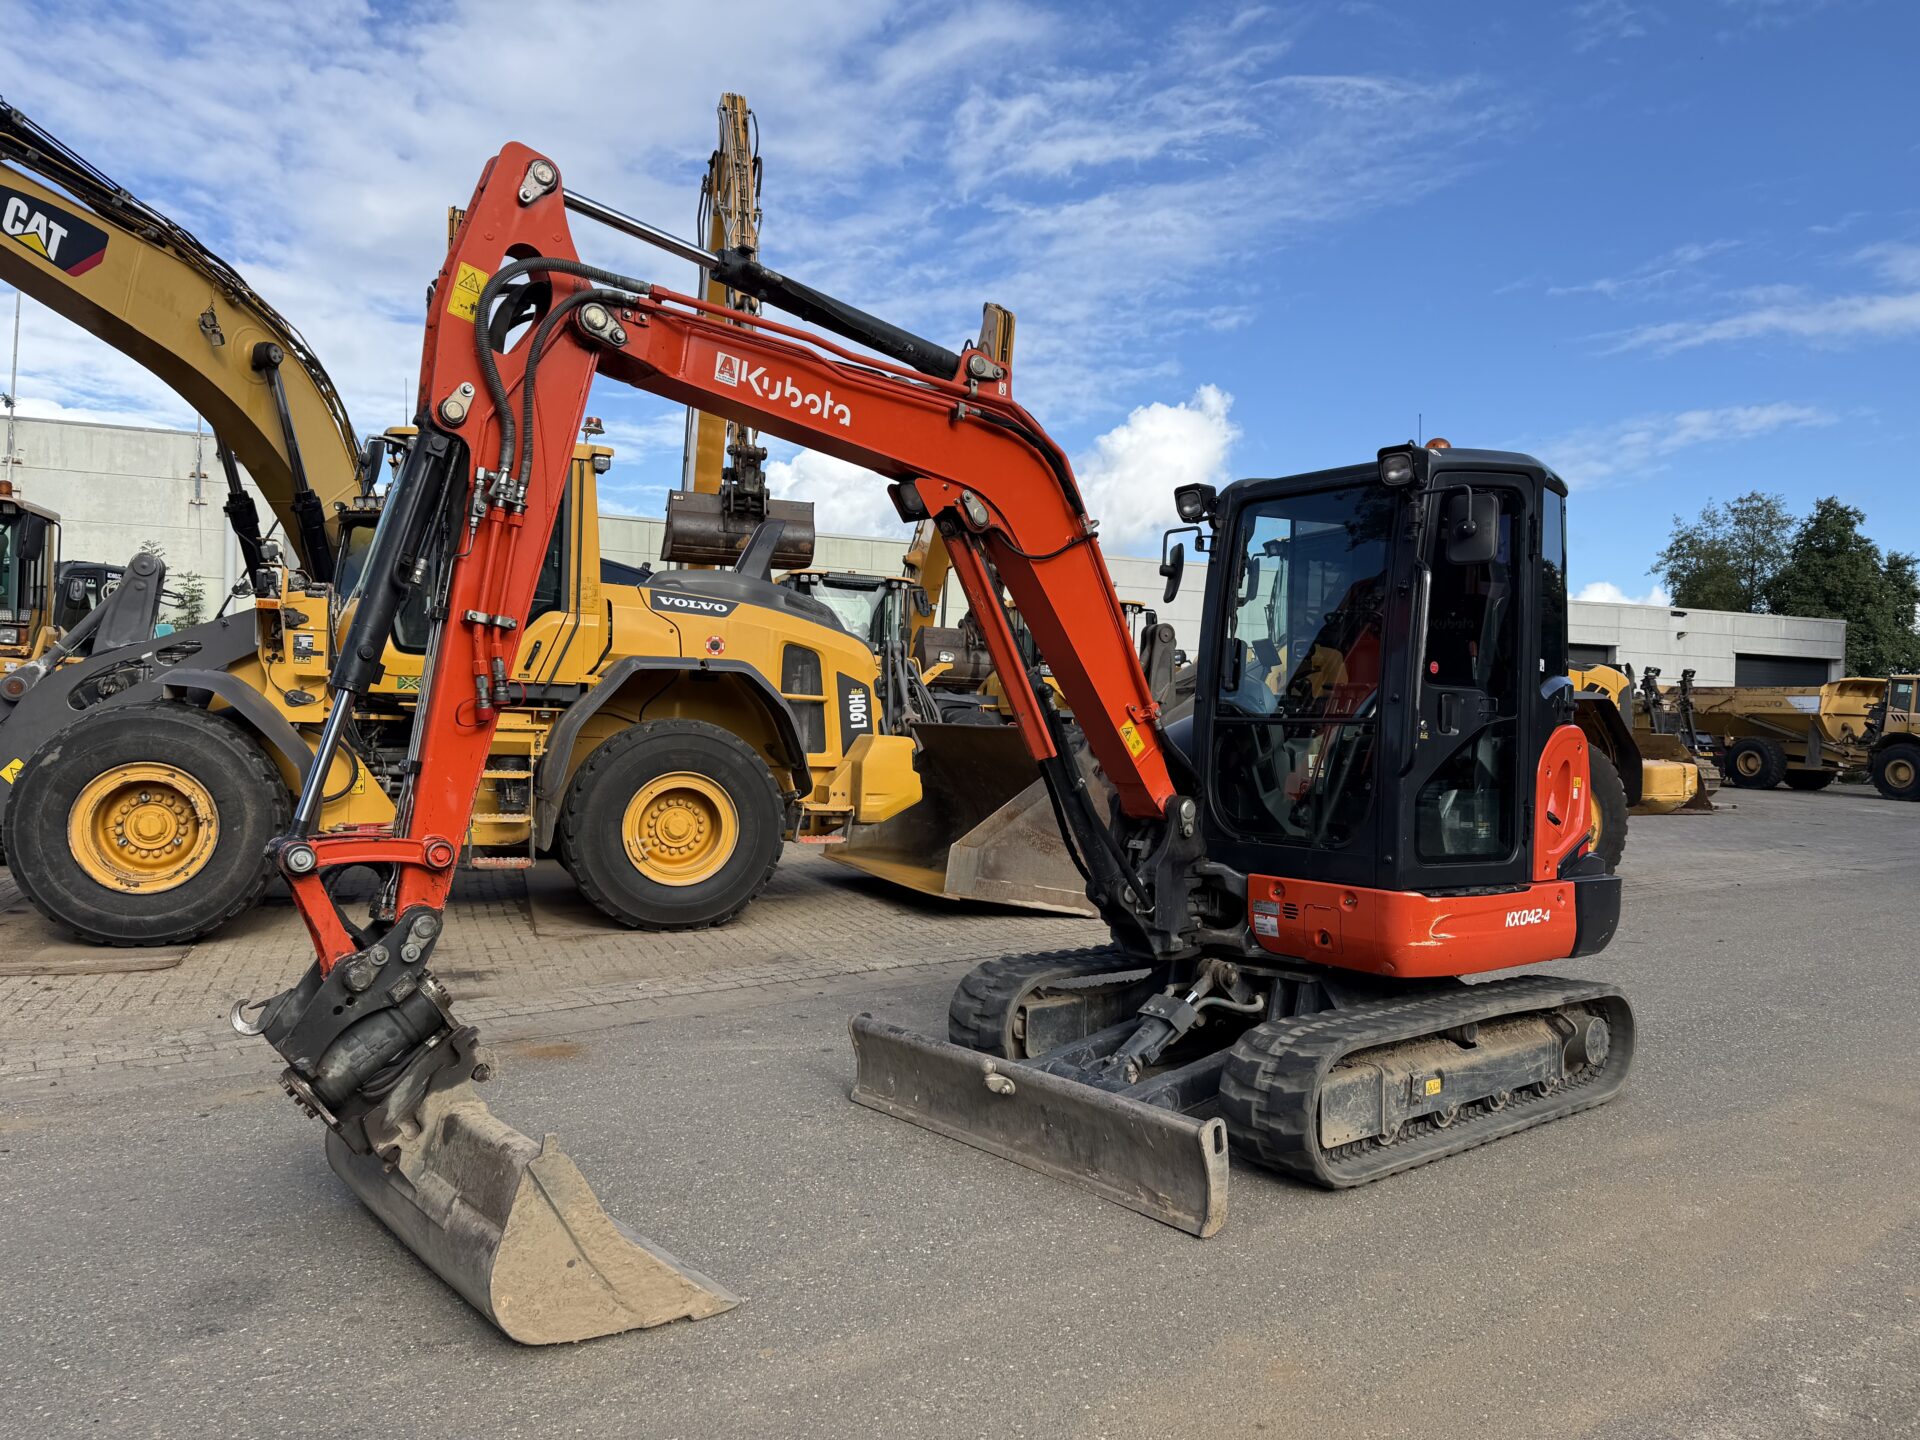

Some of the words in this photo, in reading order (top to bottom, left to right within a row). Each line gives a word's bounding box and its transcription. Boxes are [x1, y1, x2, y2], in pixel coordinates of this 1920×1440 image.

[2, 197, 68, 261] CAT
[740, 360, 851, 427] Kubota
[657, 596, 727, 612] VOLVO
[848, 694, 868, 729] L90H
[1505, 908, 1551, 928] KX042-4
